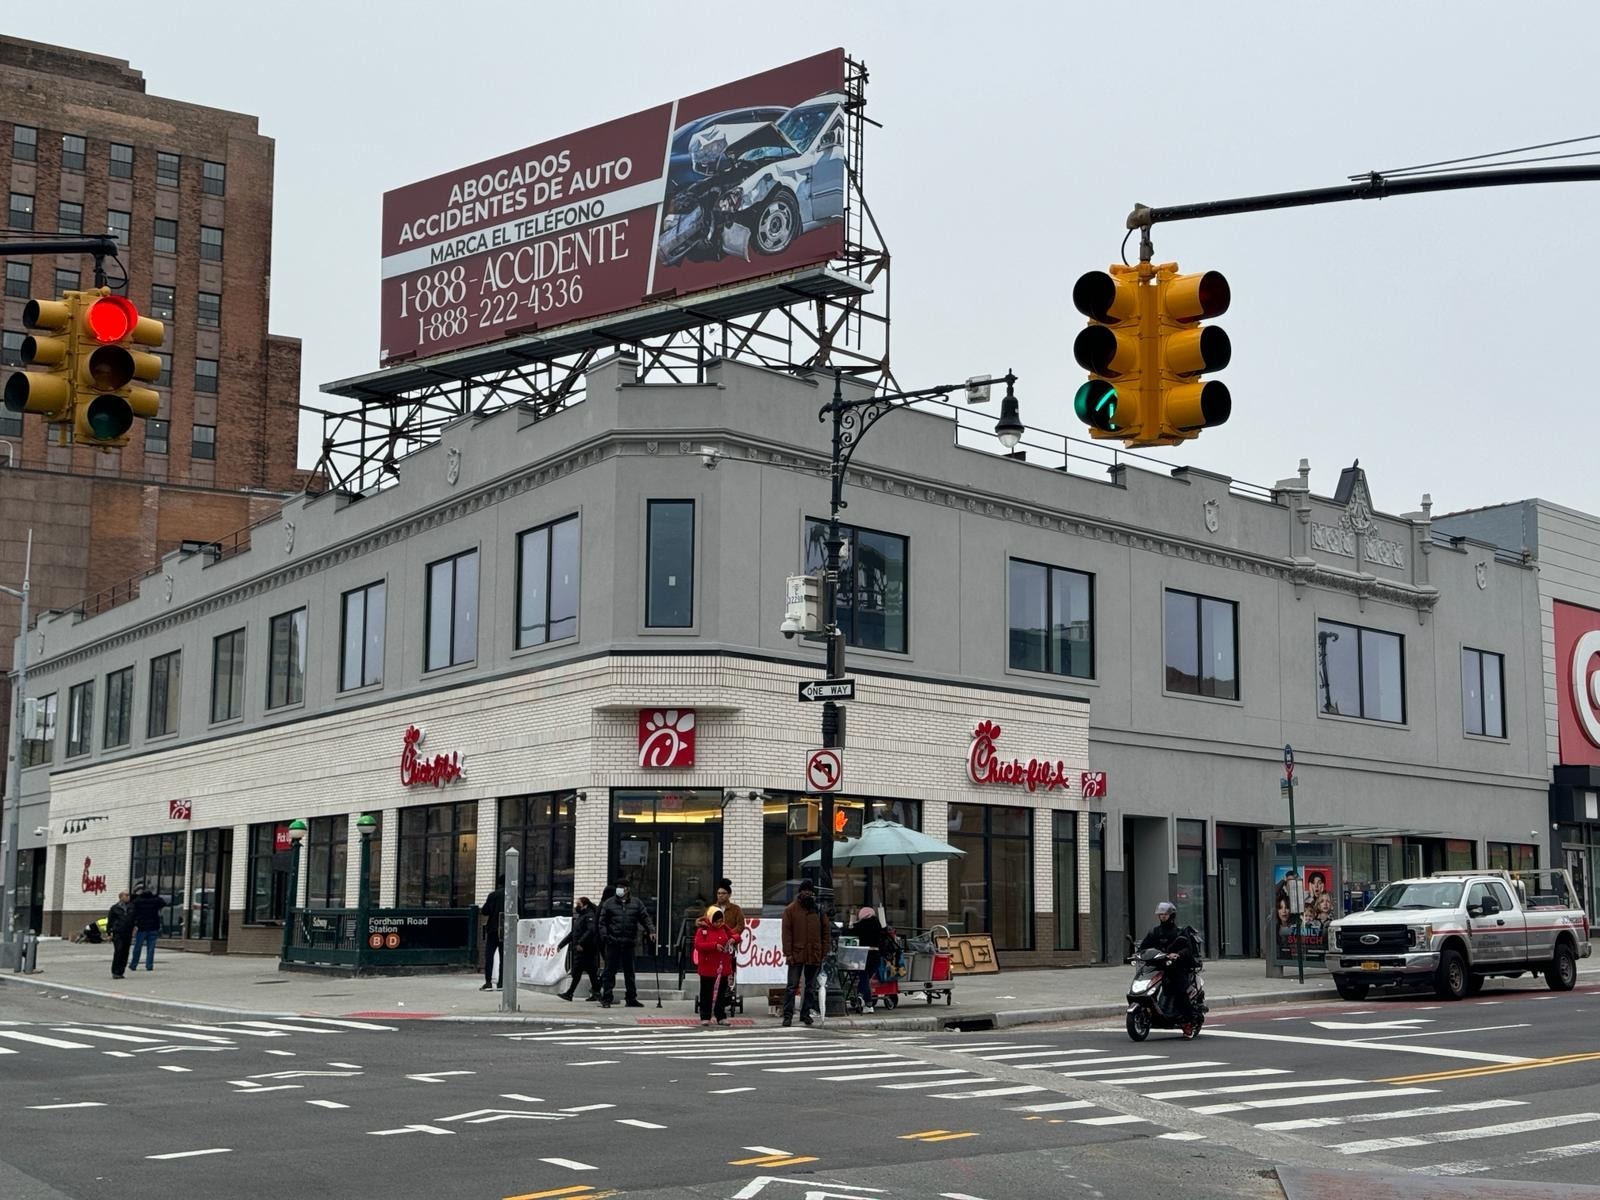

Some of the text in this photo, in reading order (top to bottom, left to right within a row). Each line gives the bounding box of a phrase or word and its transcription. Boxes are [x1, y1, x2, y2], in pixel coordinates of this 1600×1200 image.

[398, 156, 633, 245] ACCIDENTES DE AUTO
[448, 149, 571, 207] ABOGADOS
[430, 199, 605, 265] MARCA EL TELÉFONO
[806, 685, 848, 696] ONE WAY
[970, 724, 1069, 792] Chick-fil-A
[369, 917, 428, 926] Fordham Road
[369, 925, 398, 933] Station
